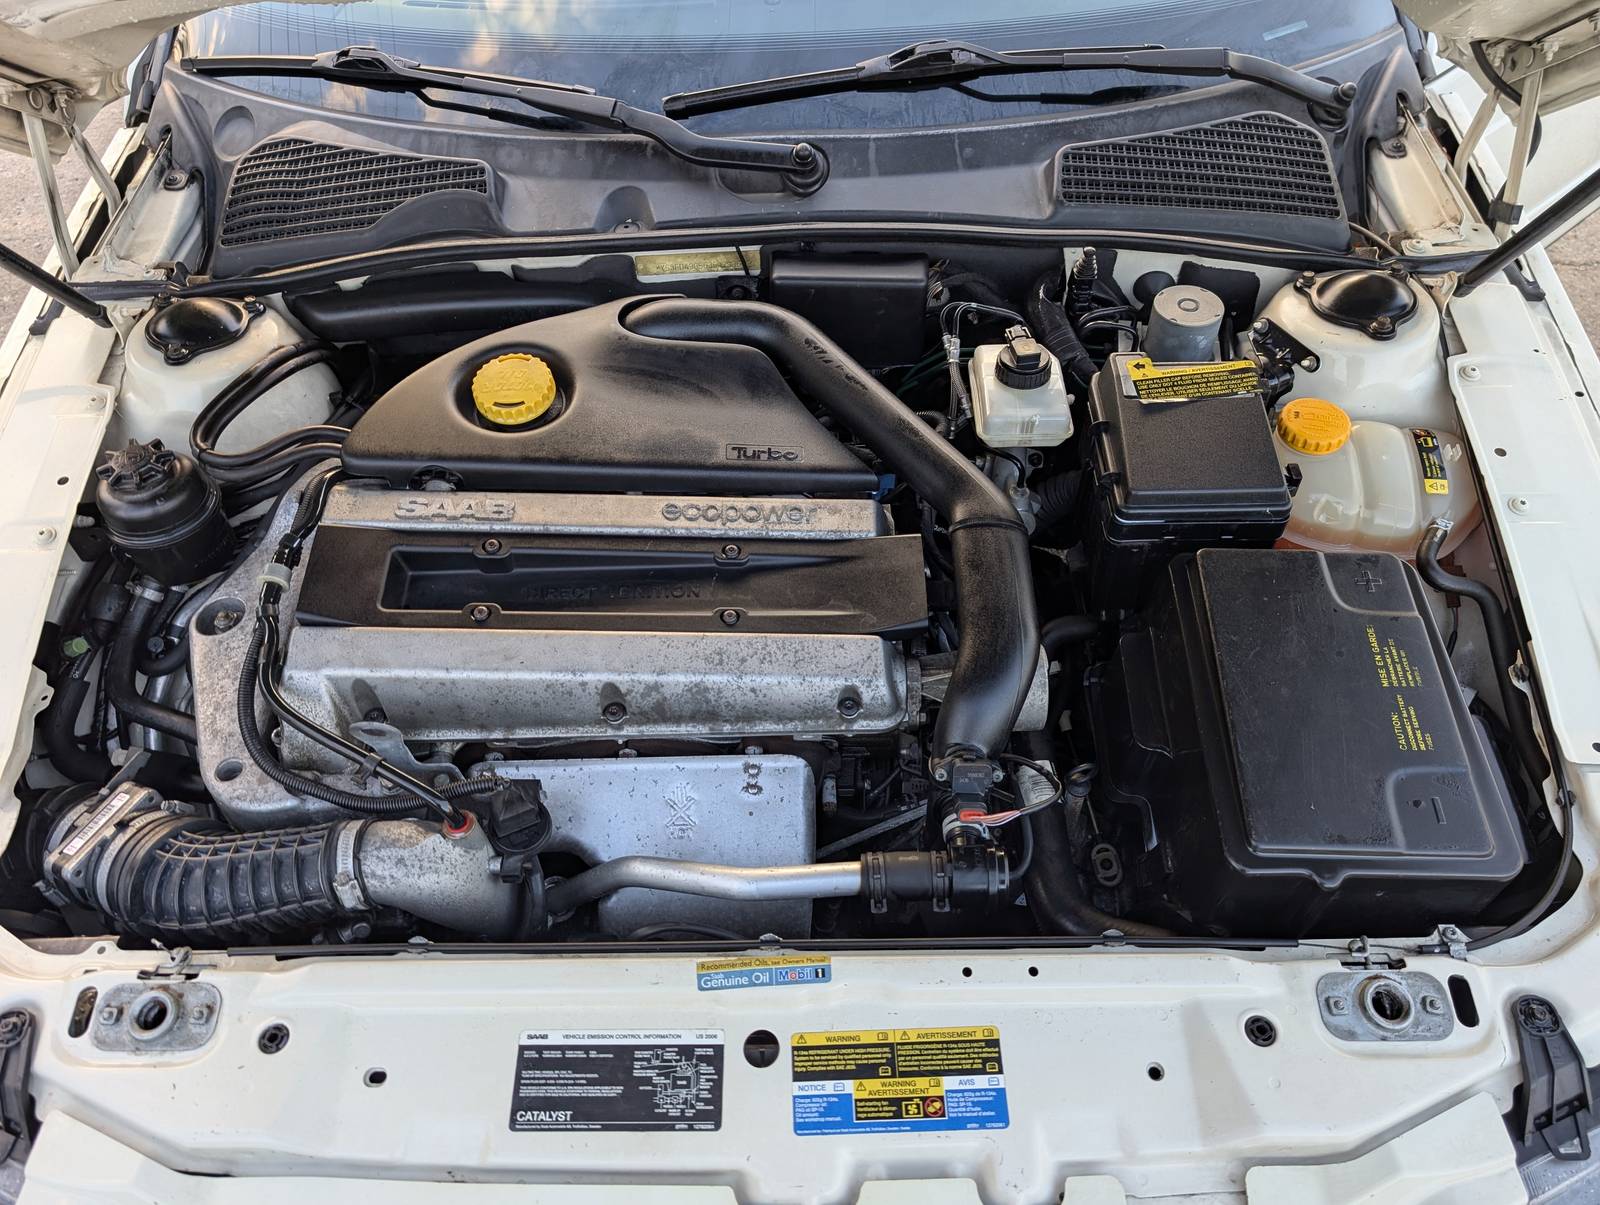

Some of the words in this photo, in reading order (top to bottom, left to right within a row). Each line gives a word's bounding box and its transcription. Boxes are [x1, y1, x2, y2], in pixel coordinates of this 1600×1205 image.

[732, 446, 798, 460] Turbo
[394, 496, 516, 521] SAAB
[662, 502, 818, 526] ecopower
[1366, 624, 1380, 653] GARDE:
[1374, 654, 1384, 665] EN
[1378, 668, 1389, 687] MISE
[1397, 694, 1408, 717] BATTERY
[1391, 712, 1407, 751] CAUTION:
[701, 961, 752, 970] Recommended
[702, 975, 749, 988] Genuine
[752, 972, 768, 983] Oil
[778, 968, 812, 981] Mobil
[916, 1031, 977, 1040] AVERTISSEMENT
[880, 1080, 916, 1088] WARNING
[868, 1088, 930, 1096] AVERTISSEMENT
[516, 1111, 573, 1121] CATALYST
